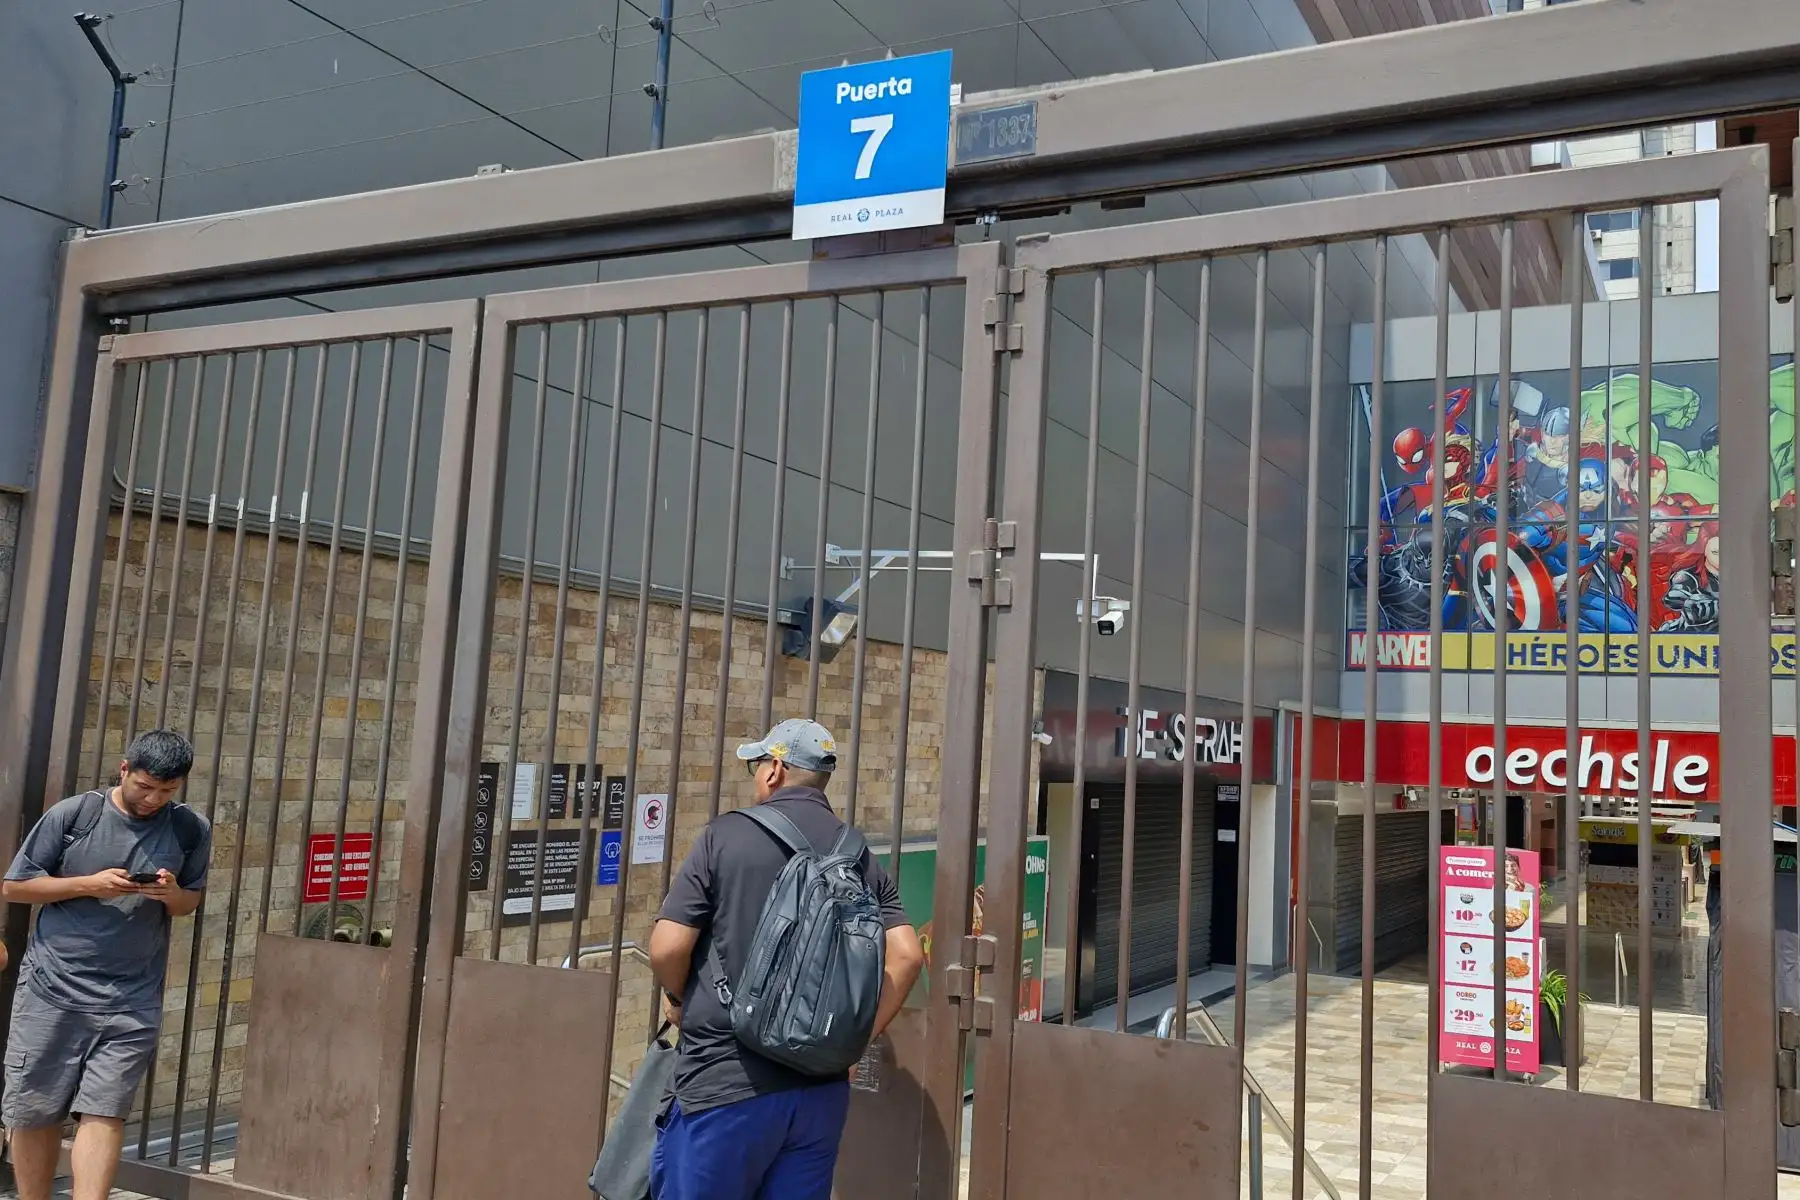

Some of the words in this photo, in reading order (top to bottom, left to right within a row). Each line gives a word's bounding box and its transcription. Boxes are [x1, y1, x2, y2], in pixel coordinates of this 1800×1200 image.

[836, 76, 912, 104] Puerta
[850, 113, 894, 180] 7
[831, 213, 853, 222] REAL
[875, 207, 904, 217] PLAZA
[1507, 636, 1639, 669] HÉROES
[1657, 644, 1797, 670] UNIS
[1173, 713, 1243, 764] SFRAH
[1465, 735, 1709, 794] oechsle
[1025, 855, 1046, 875] OHNS
[1445, 866, 1457, 877] A
[1458, 868, 1494, 880] comer
[1460, 959, 1477, 973] 17
[1453, 1008, 1475, 1022] 29
[1455, 1041, 1477, 1051] REAL
[1505, 1046, 1521, 1056] AZA
